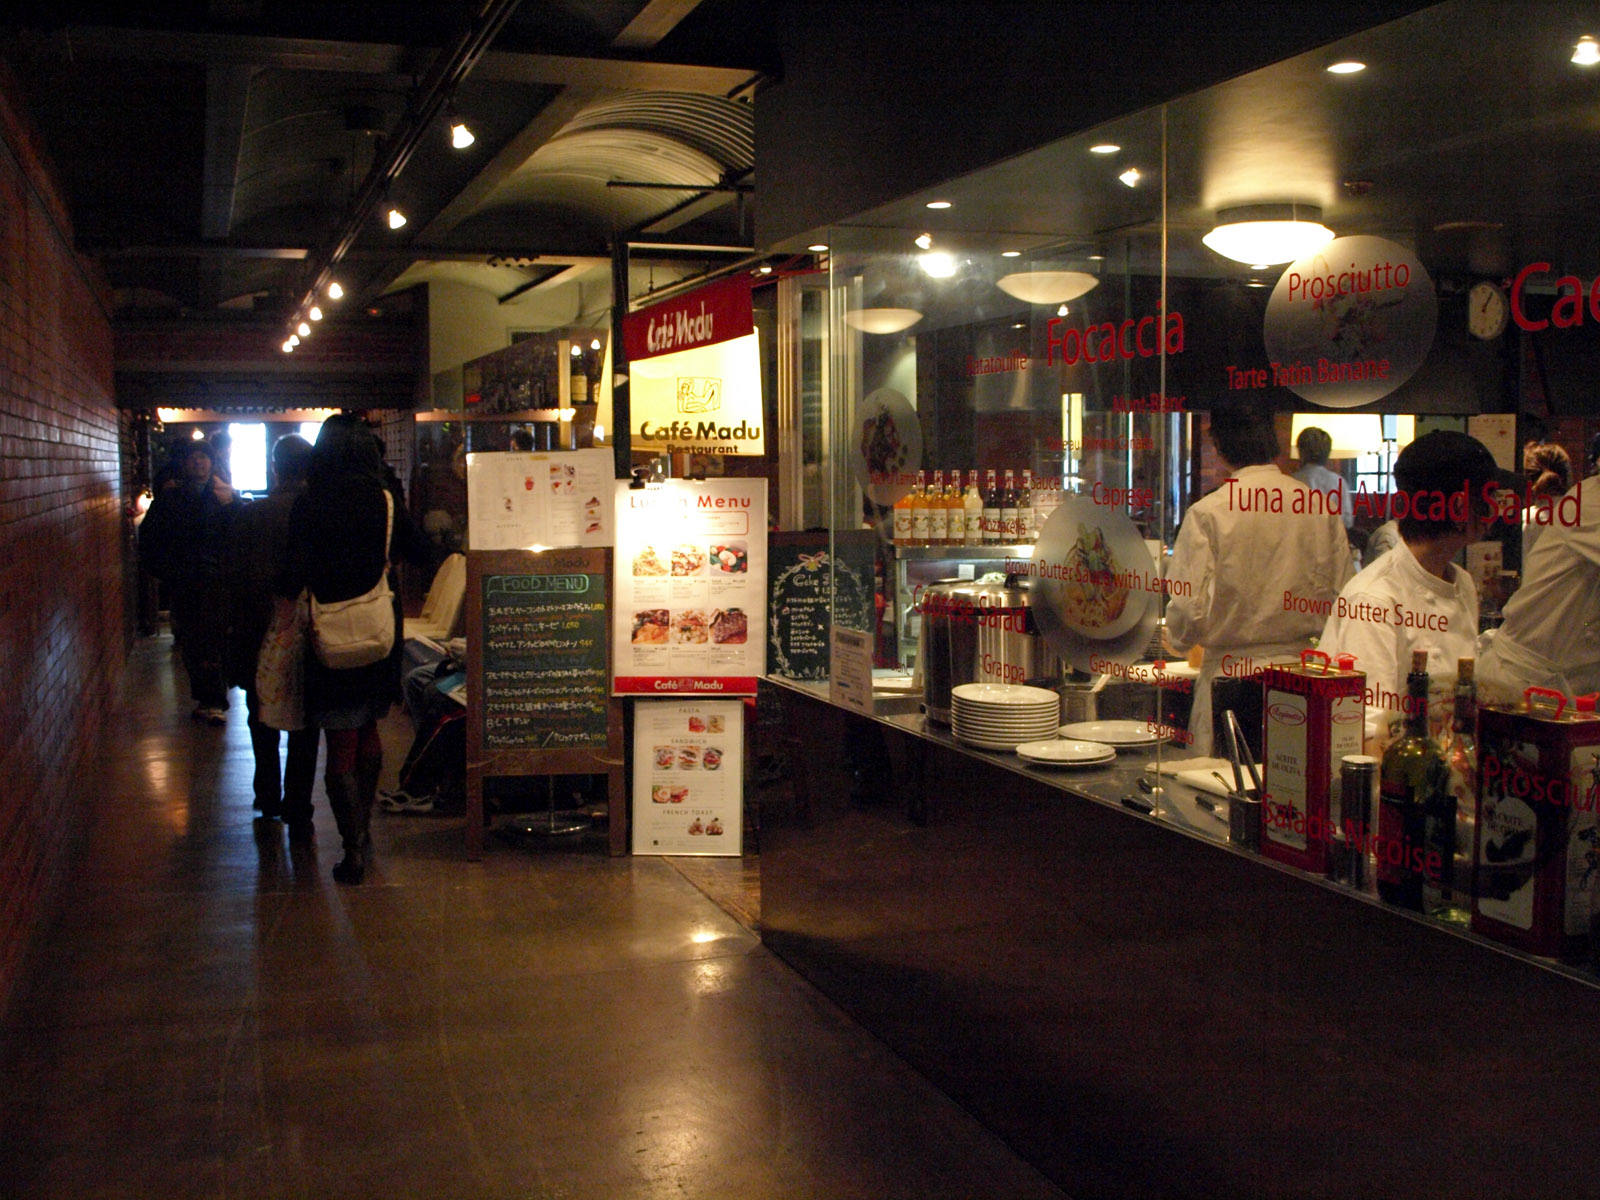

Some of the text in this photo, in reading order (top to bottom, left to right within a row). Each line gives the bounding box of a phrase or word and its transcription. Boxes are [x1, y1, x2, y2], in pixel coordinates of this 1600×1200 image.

[1288, 262, 1411, 302] Prosciutto
[674, 302, 714, 345] Madu
[1048, 300, 1185, 367] Focaccia
[966, 350, 1027, 376] Ratatouille
[1226, 358, 1391, 389] Tarte Tatin Banane
[1112, 393, 1187, 414] Mont-Blanc
[641, 420, 761, 441] Café Madu
[666, 443, 738, 454] Restaurant
[1030, 471, 1061, 490] Sauce
[697, 495, 751, 508] Menu
[1092, 481, 1153, 512] Caprese
[1223, 478, 1582, 528] Tuna and Avocad Salad
[502, 577, 584, 591] FOOD MENU
[822, 572, 839, 587] St
[1005, 556, 1192, 597] Brown Butter Sauce with Lemon
[913, 584, 1027, 634] Caprese Salad
[1283, 591, 1449, 632] Brown Butter Sauce
[654, 679, 724, 690] Café Madu
[983, 654, 1026, 684] Grappa
[1089, 653, 1192, 694] Genovese Sauce
[1222, 654, 1273, 685] Grilled
[1352, 681, 1428, 716] Salmon
[1147, 716, 1195, 745] Espresso
[1261, 794, 1443, 878] Salade Niçoise
